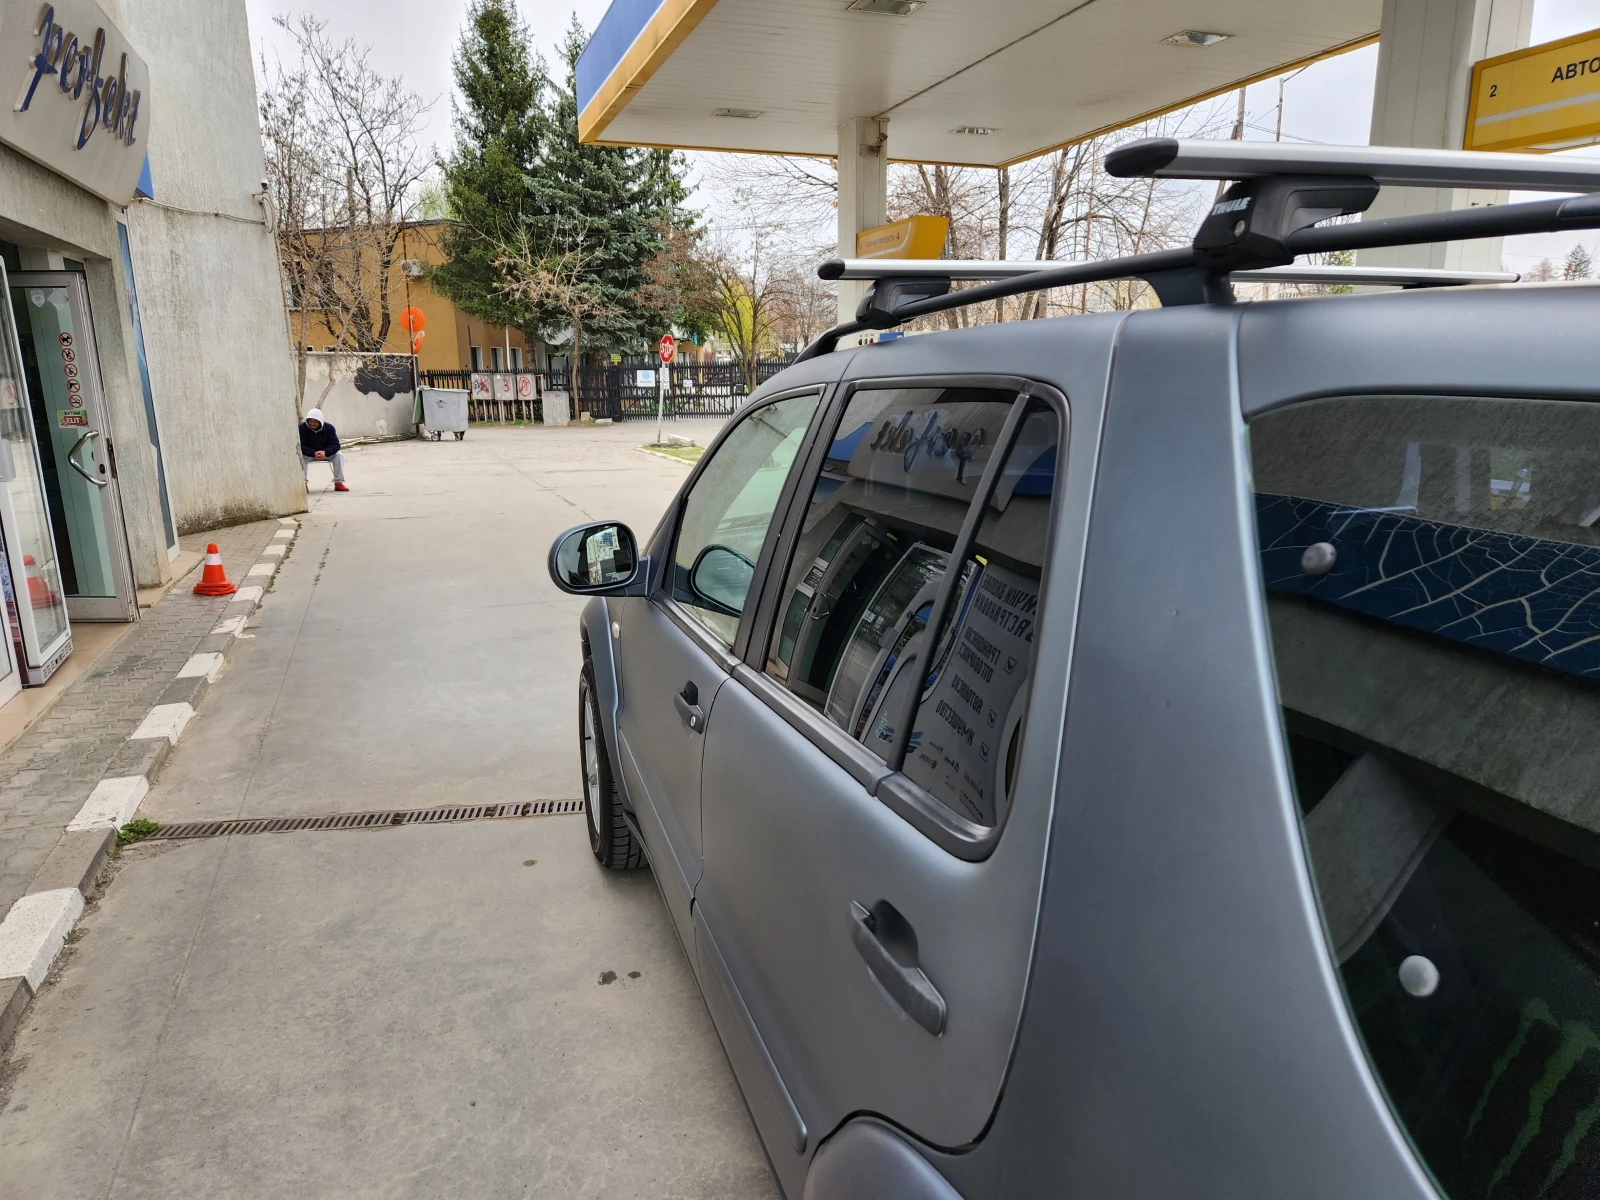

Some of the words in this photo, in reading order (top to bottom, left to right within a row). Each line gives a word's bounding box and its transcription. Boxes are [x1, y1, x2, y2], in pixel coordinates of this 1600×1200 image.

[14, 3, 142, 150] perfekt
[1489, 85, 1498, 97] 2
[1551, 56, 1600, 83] АВТО
[1211, 197, 1252, 216] THULE
[660, 341, 673, 355] STOP
